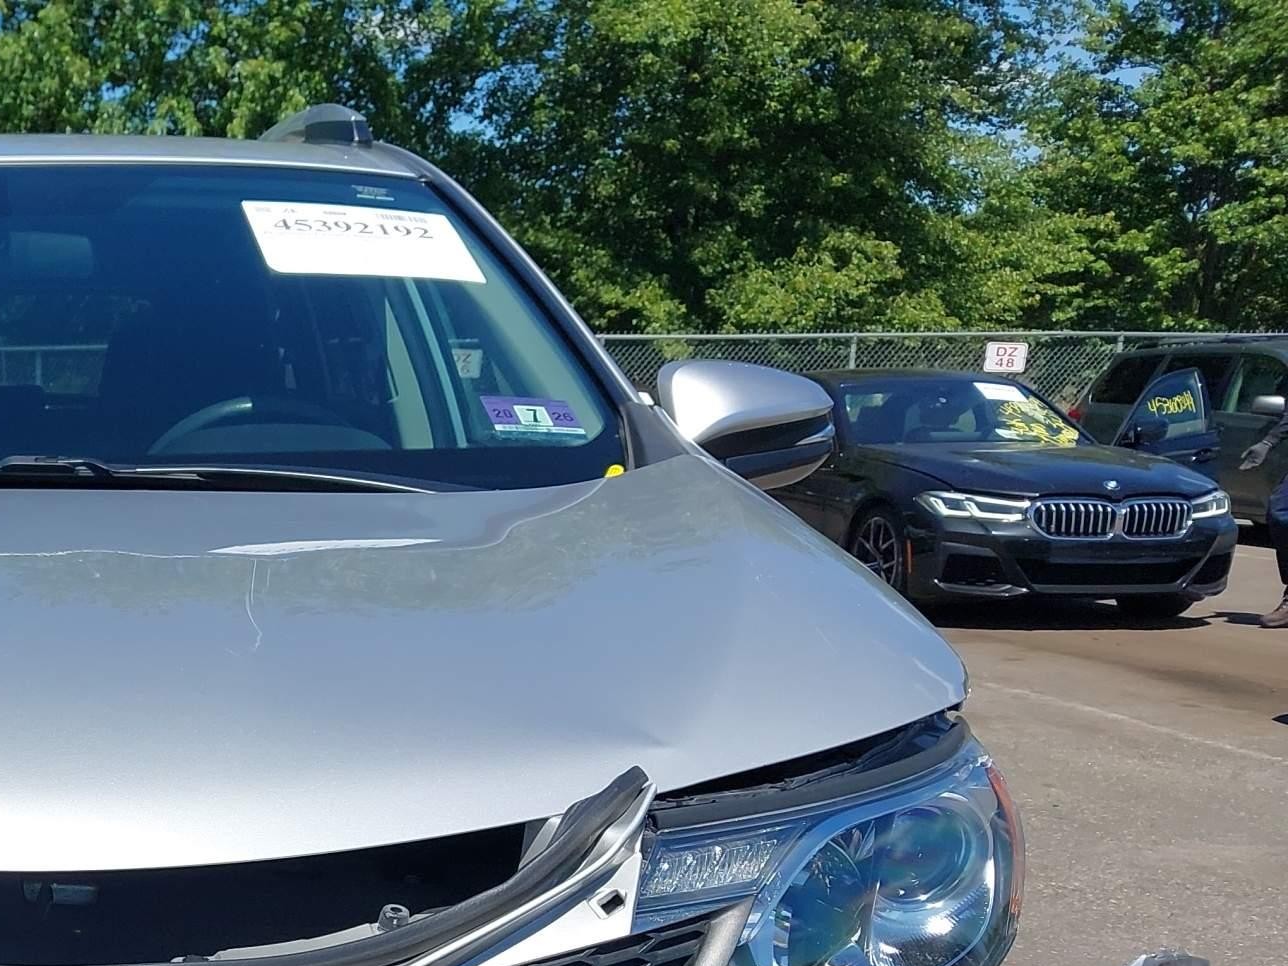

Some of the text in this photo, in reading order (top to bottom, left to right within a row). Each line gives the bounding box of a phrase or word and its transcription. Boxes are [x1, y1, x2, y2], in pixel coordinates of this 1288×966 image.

[273, 217, 434, 240] 45392192
[996, 346, 1019, 357] DZ
[994, 358, 1015, 368] 48
[492, 408, 575, 423] 20 7 26
